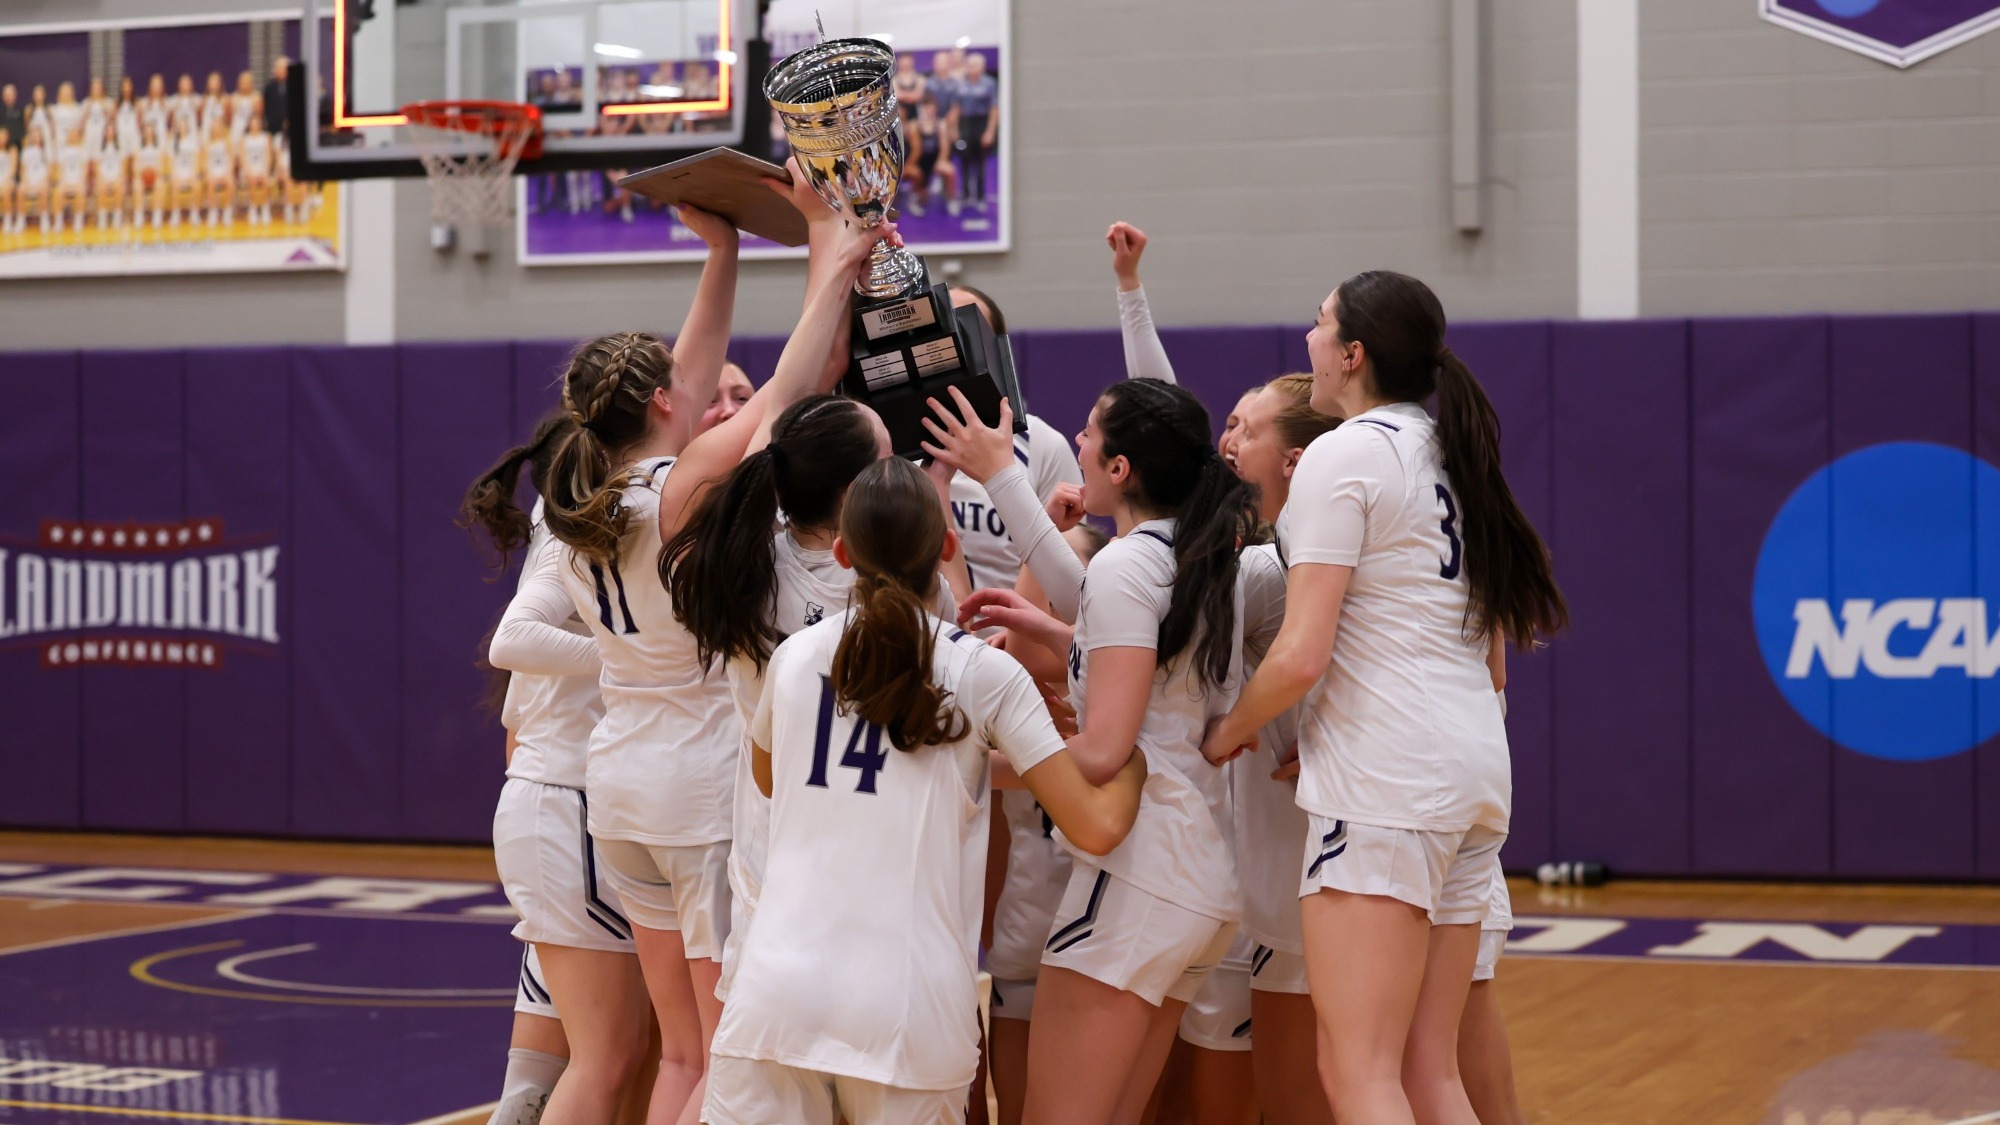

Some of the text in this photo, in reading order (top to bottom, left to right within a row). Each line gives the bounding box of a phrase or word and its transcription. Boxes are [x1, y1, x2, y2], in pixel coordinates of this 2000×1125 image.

[1434, 483, 1460, 580] 3
[48, 640, 215, 665] CONFERENCE
[1784, 598, 2000, 679] NCA
[805, 671, 890, 796] 14
